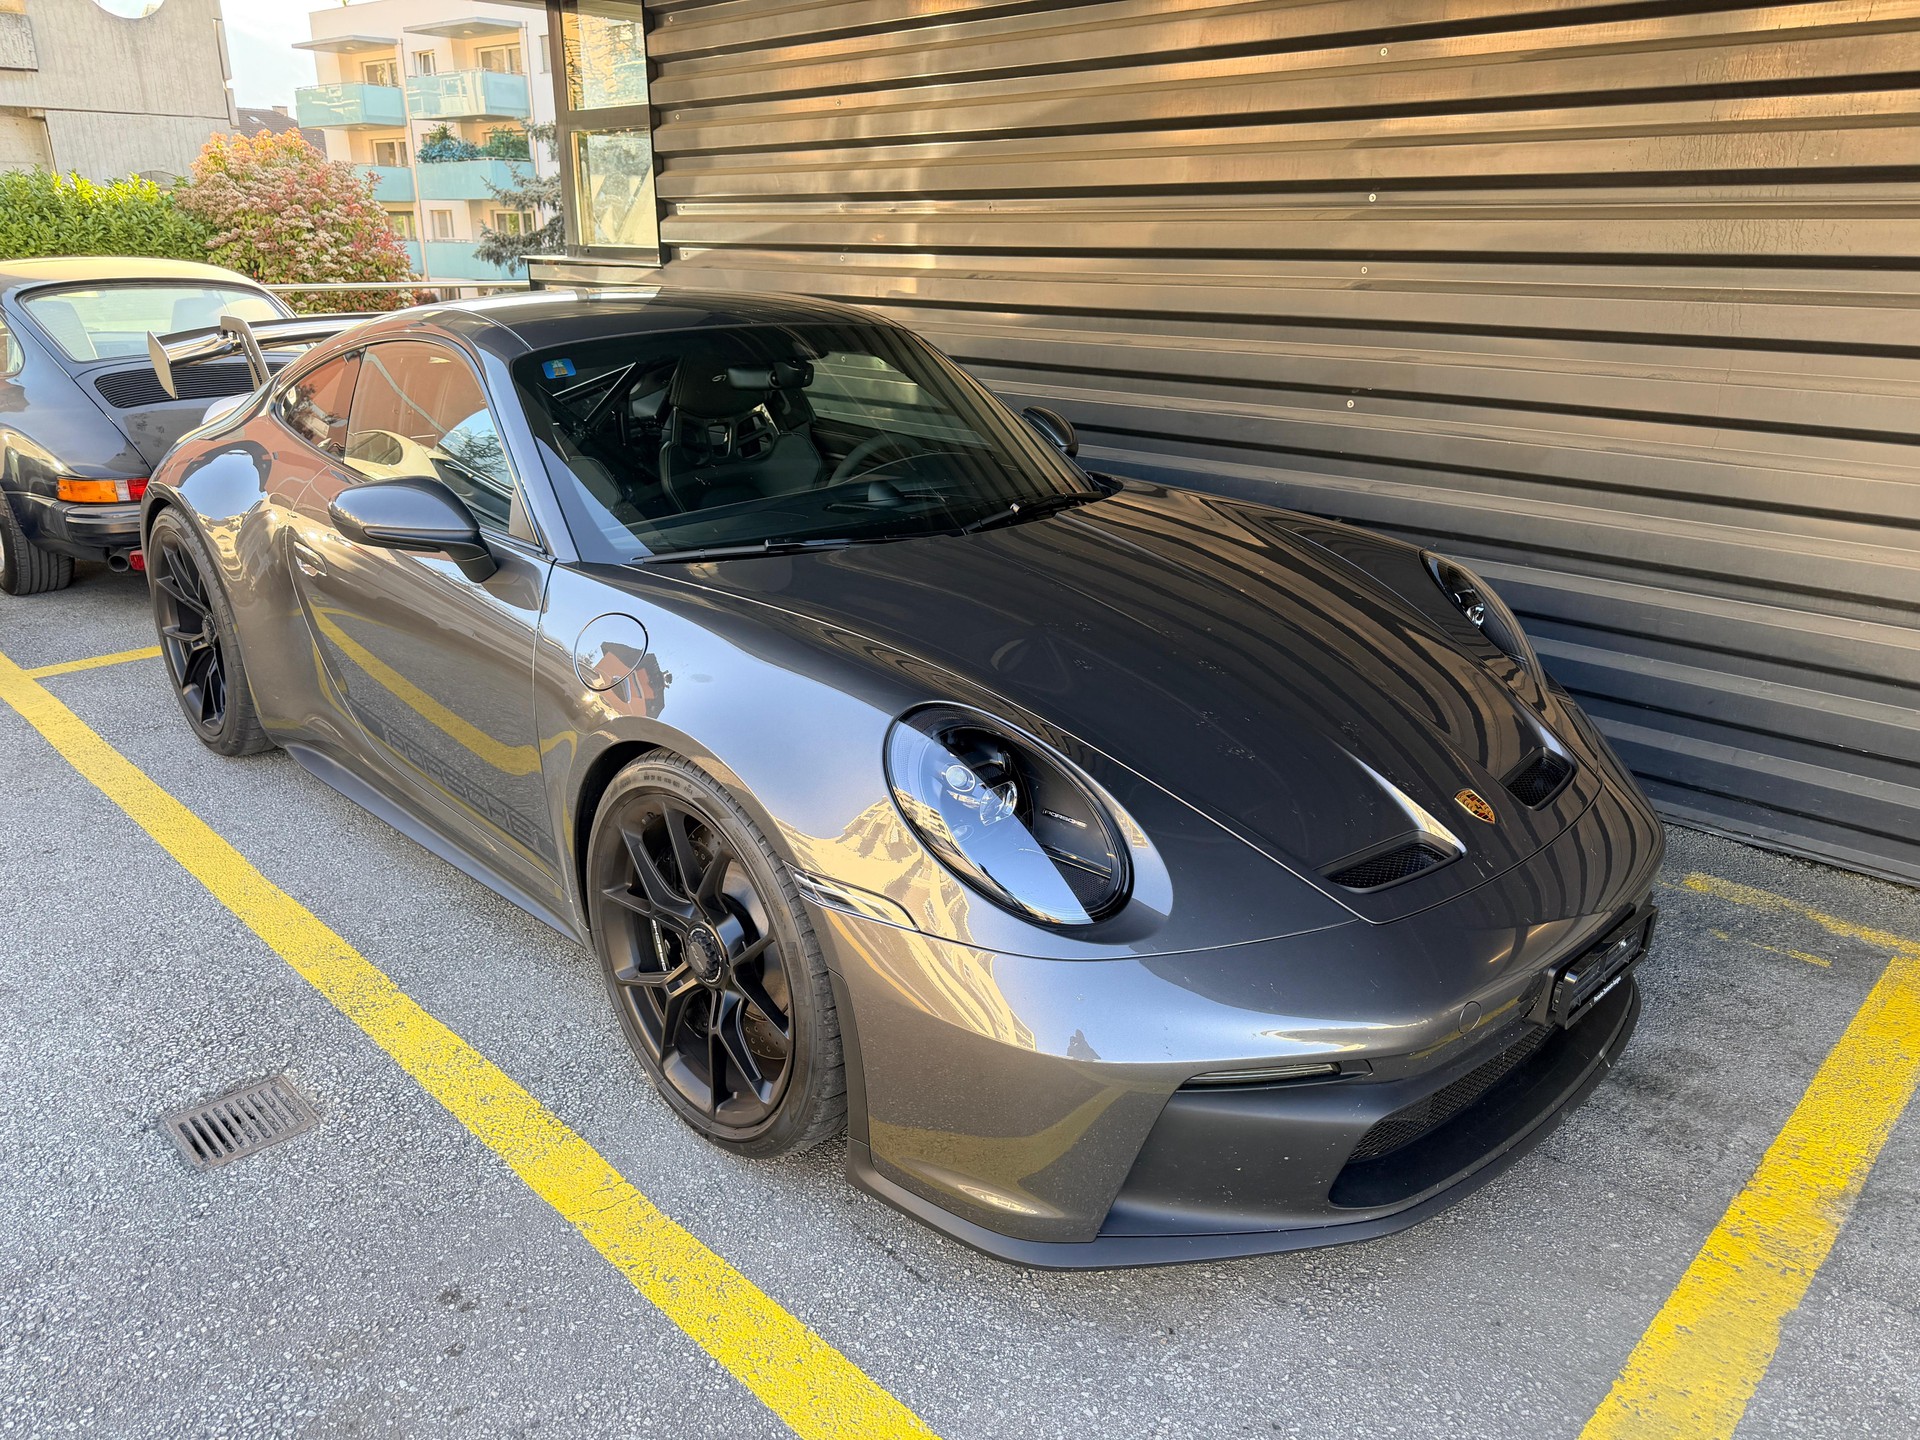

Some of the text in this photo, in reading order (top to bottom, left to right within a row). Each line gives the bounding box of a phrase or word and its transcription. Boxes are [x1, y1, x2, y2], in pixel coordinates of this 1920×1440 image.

[387, 728, 536, 847] PORSCHE
[1043, 809, 1088, 828] PORSCHE
[652, 919, 667, 971] ORSCHE
